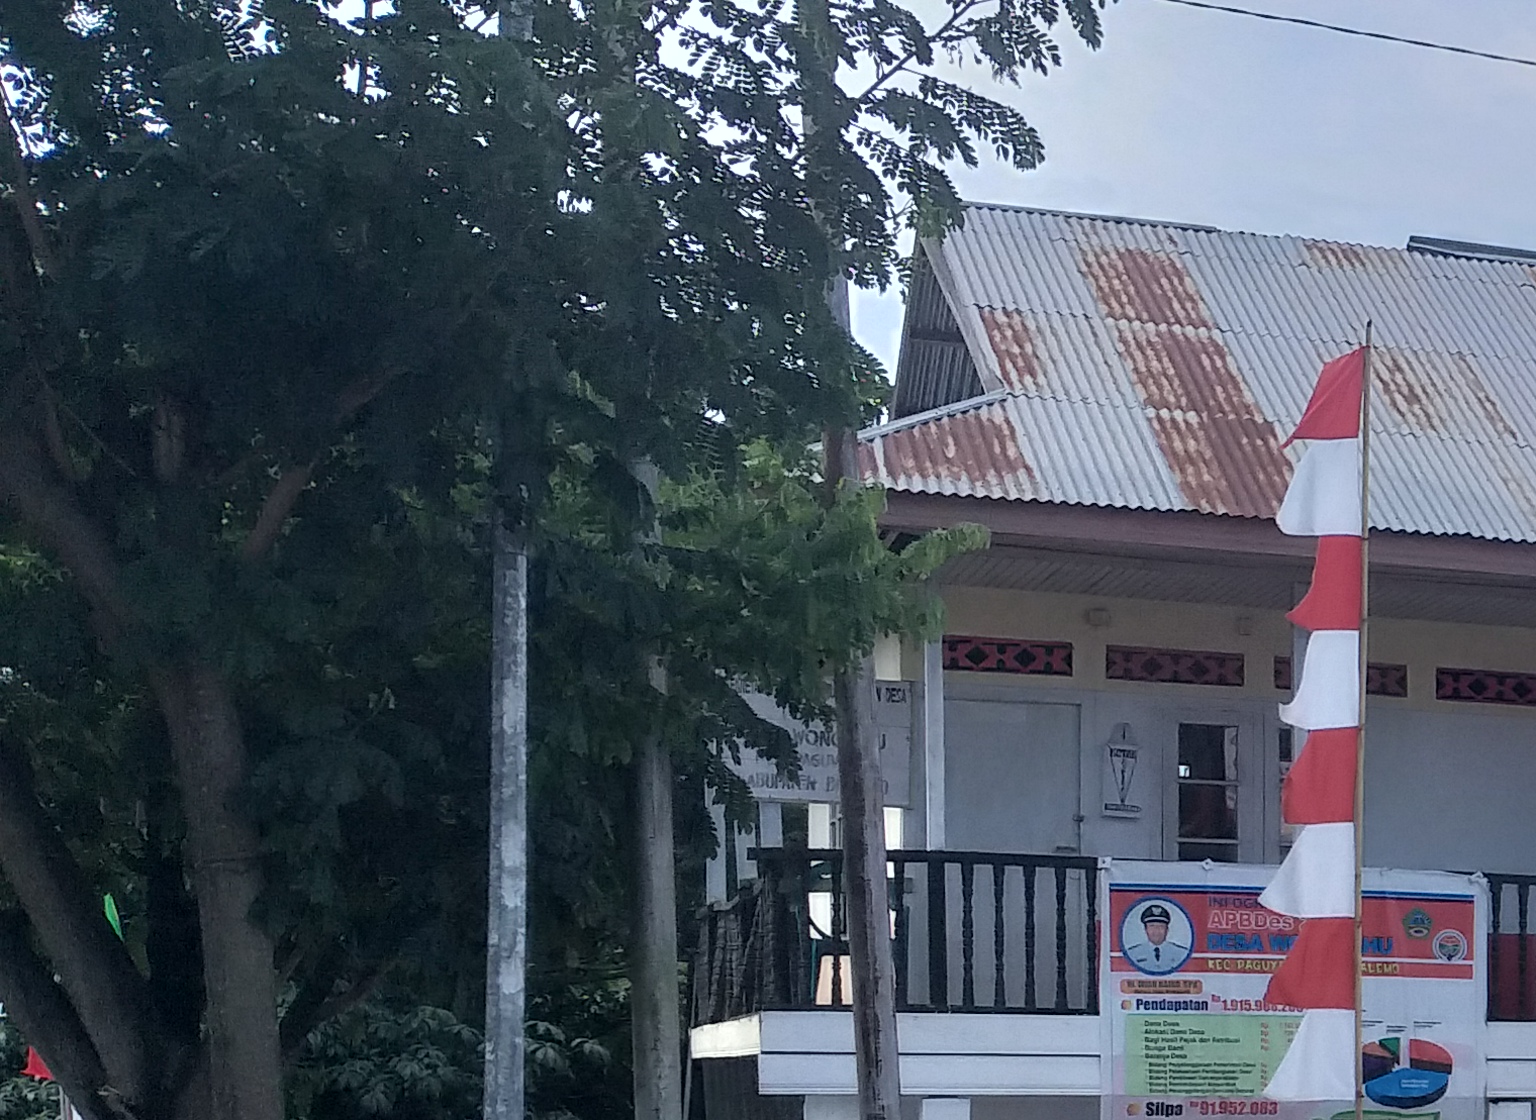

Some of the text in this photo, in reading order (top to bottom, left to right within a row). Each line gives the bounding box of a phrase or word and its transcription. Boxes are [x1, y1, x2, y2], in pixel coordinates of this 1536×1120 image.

[1207, 909, 1295, 931] APBDes
[1206, 932, 1264, 952] DESA
[1136, 998, 1209, 1013] Pendapatan
[1145, 1101, 1184, 1118] Silpa
